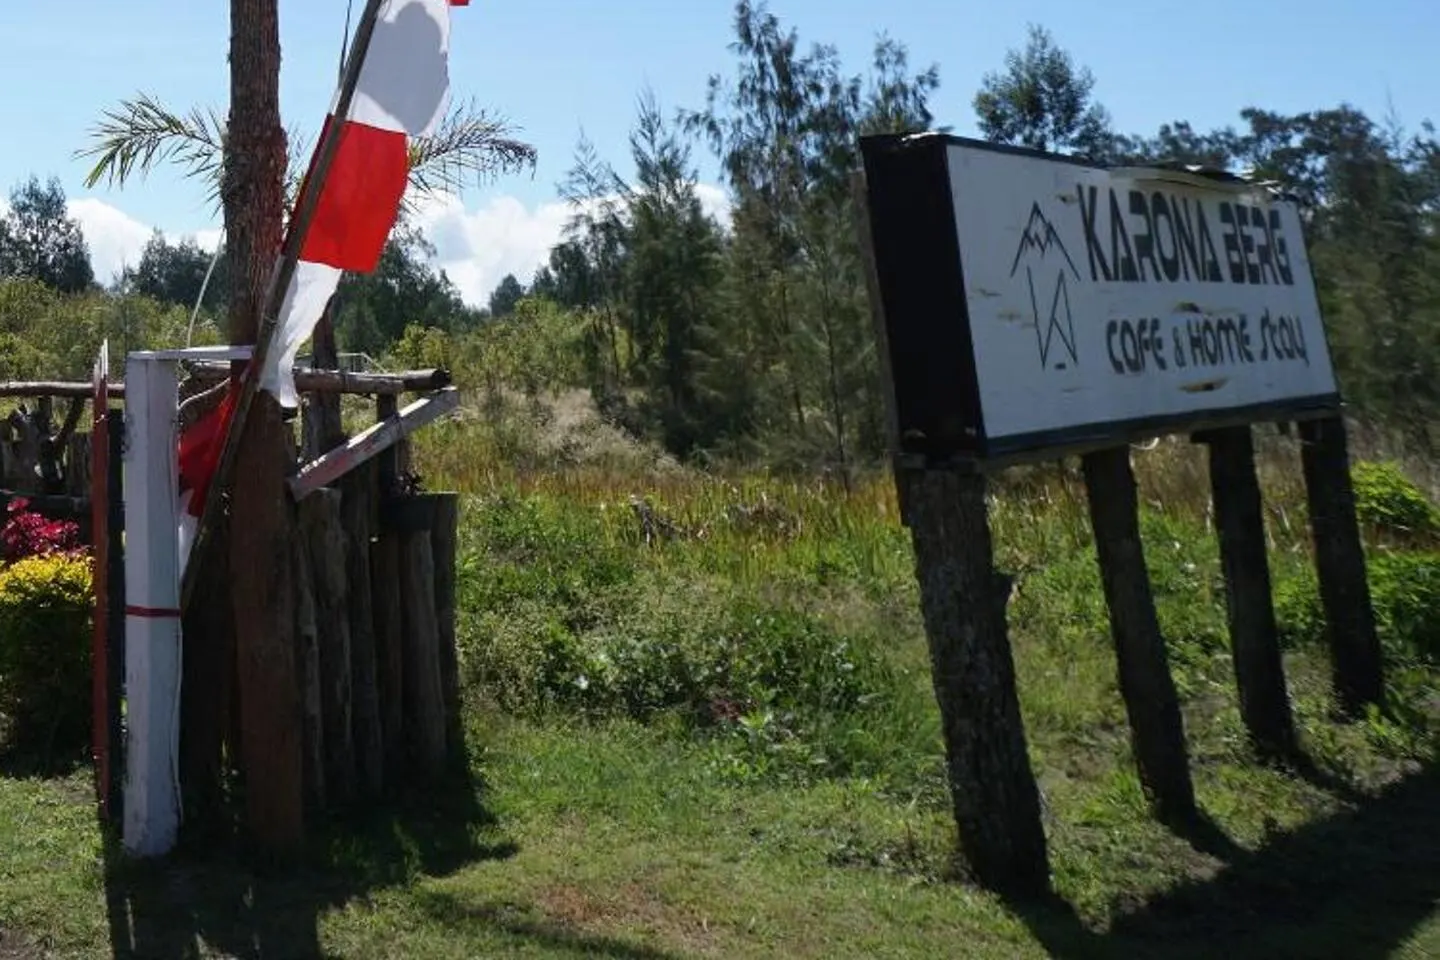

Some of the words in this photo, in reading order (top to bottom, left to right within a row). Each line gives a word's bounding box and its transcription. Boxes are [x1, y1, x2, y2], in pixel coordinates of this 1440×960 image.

[1076, 184, 1224, 282] KARONA
[1219, 201, 1294, 285] BERG
[1172, 326, 1187, 368] &
